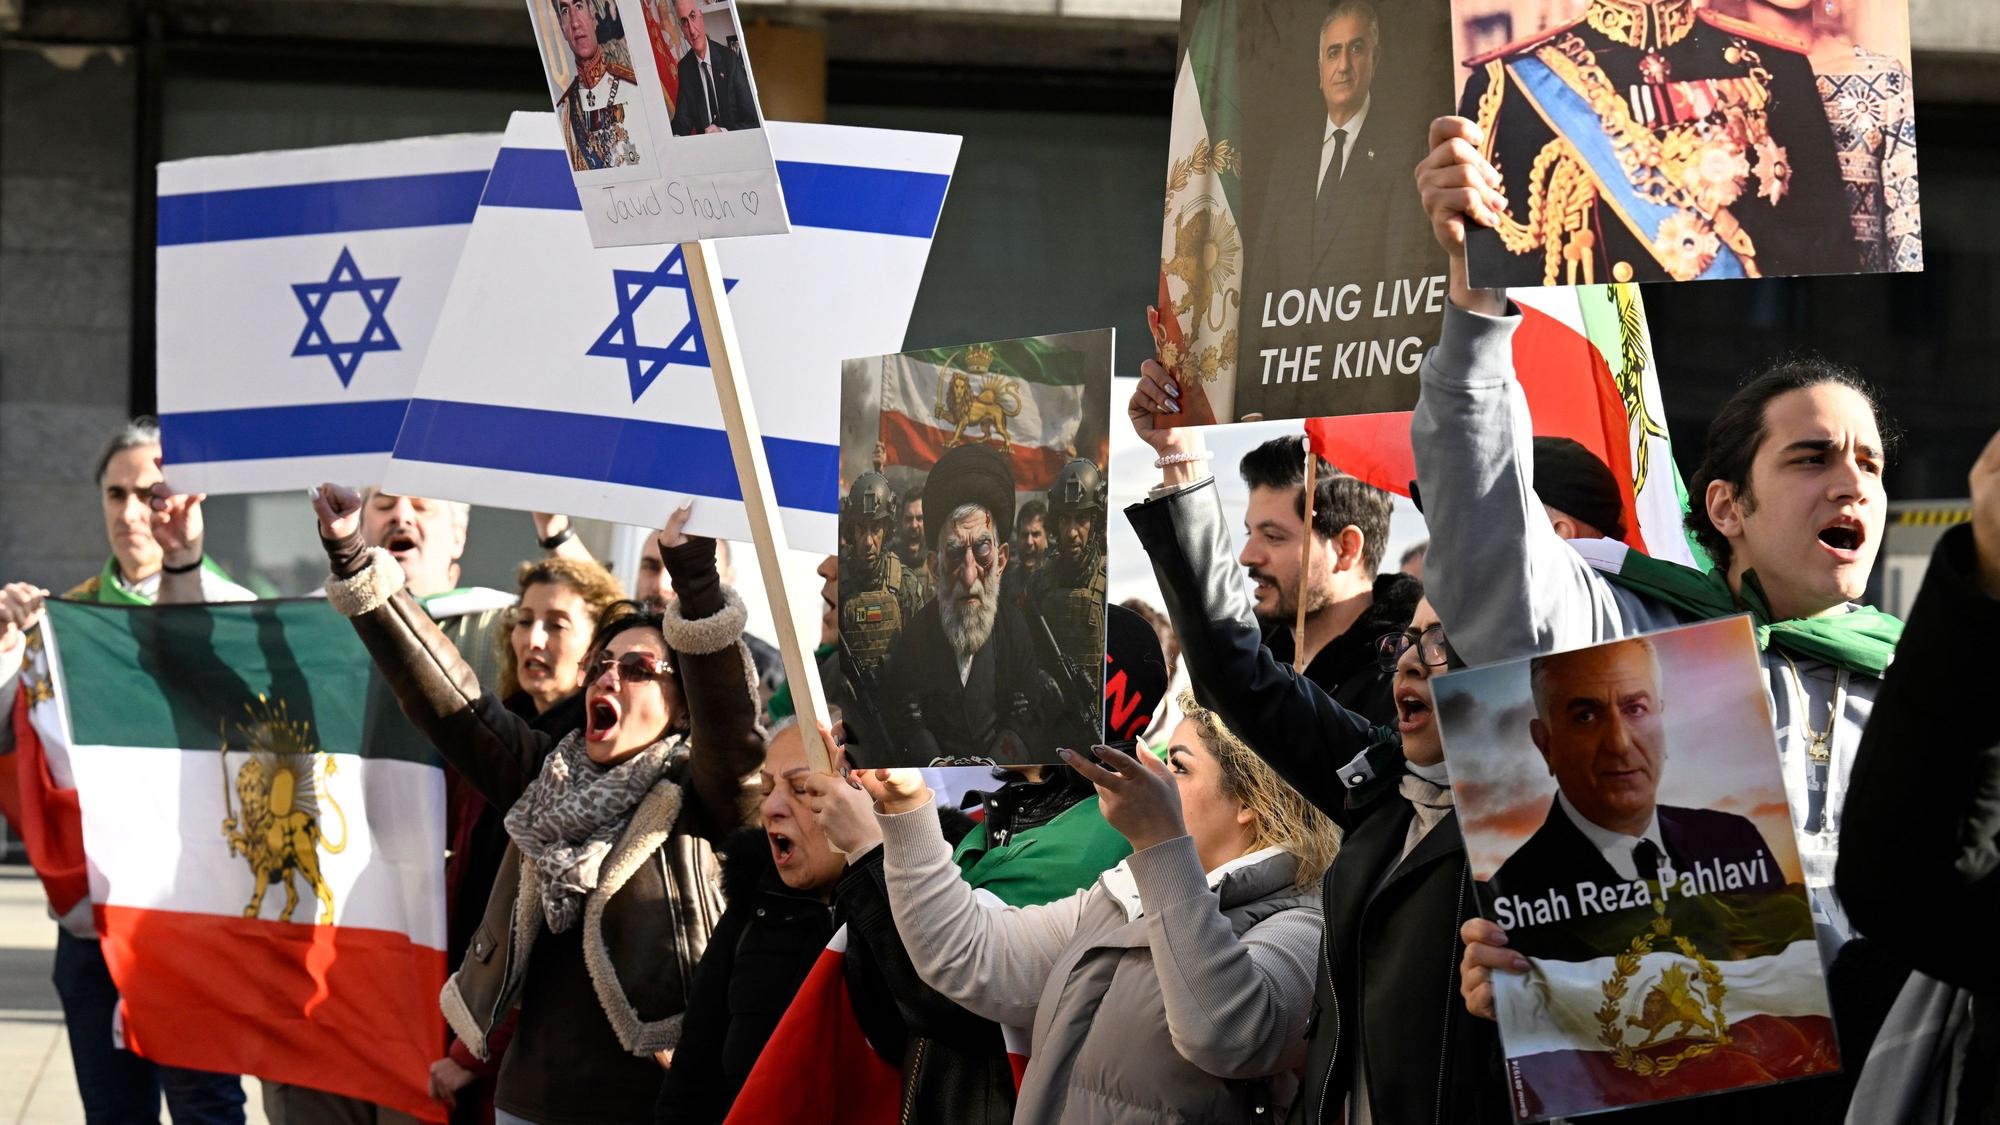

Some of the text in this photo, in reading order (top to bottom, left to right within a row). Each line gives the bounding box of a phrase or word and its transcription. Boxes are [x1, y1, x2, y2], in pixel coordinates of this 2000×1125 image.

[602, 181, 735, 224] Javid Shah
[1261, 275, 1447, 328] LONG LIVE
[1260, 336, 1423, 385] THE KING
[1493, 850, 1769, 931] Shah Reza Pahlavi
